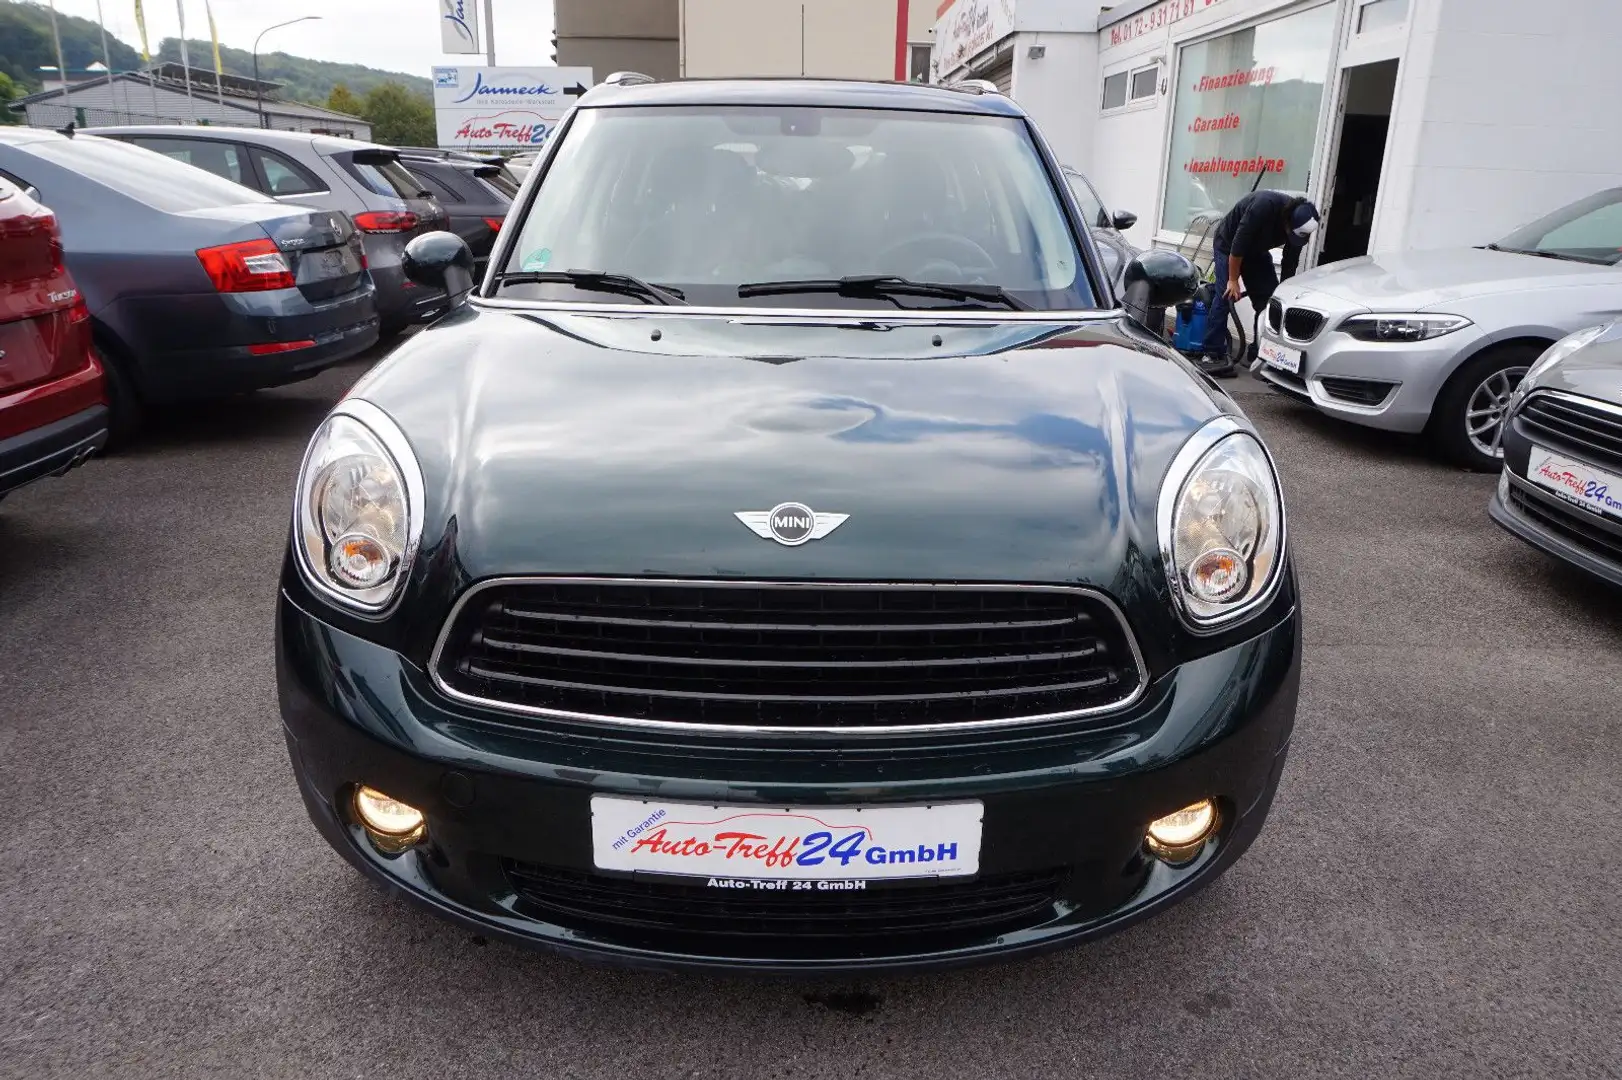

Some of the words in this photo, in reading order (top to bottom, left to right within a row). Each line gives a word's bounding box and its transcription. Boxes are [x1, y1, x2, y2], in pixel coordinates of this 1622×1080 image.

[1199, 66, 1275, 92] Finanzierung
[1194, 113, 1240, 133] Garantie
[1188, 155, 1284, 177] Inzahlungnahme
[774, 516, 810, 529] MINI
[611, 835, 628, 850] mit
[626, 807, 667, 839] Garantie
[865, 842, 958, 865] GmbH
[707, 877, 788, 890] Auto-Treff
[792, 881, 812, 890] 24
[817, 880, 866, 890] GmbH
